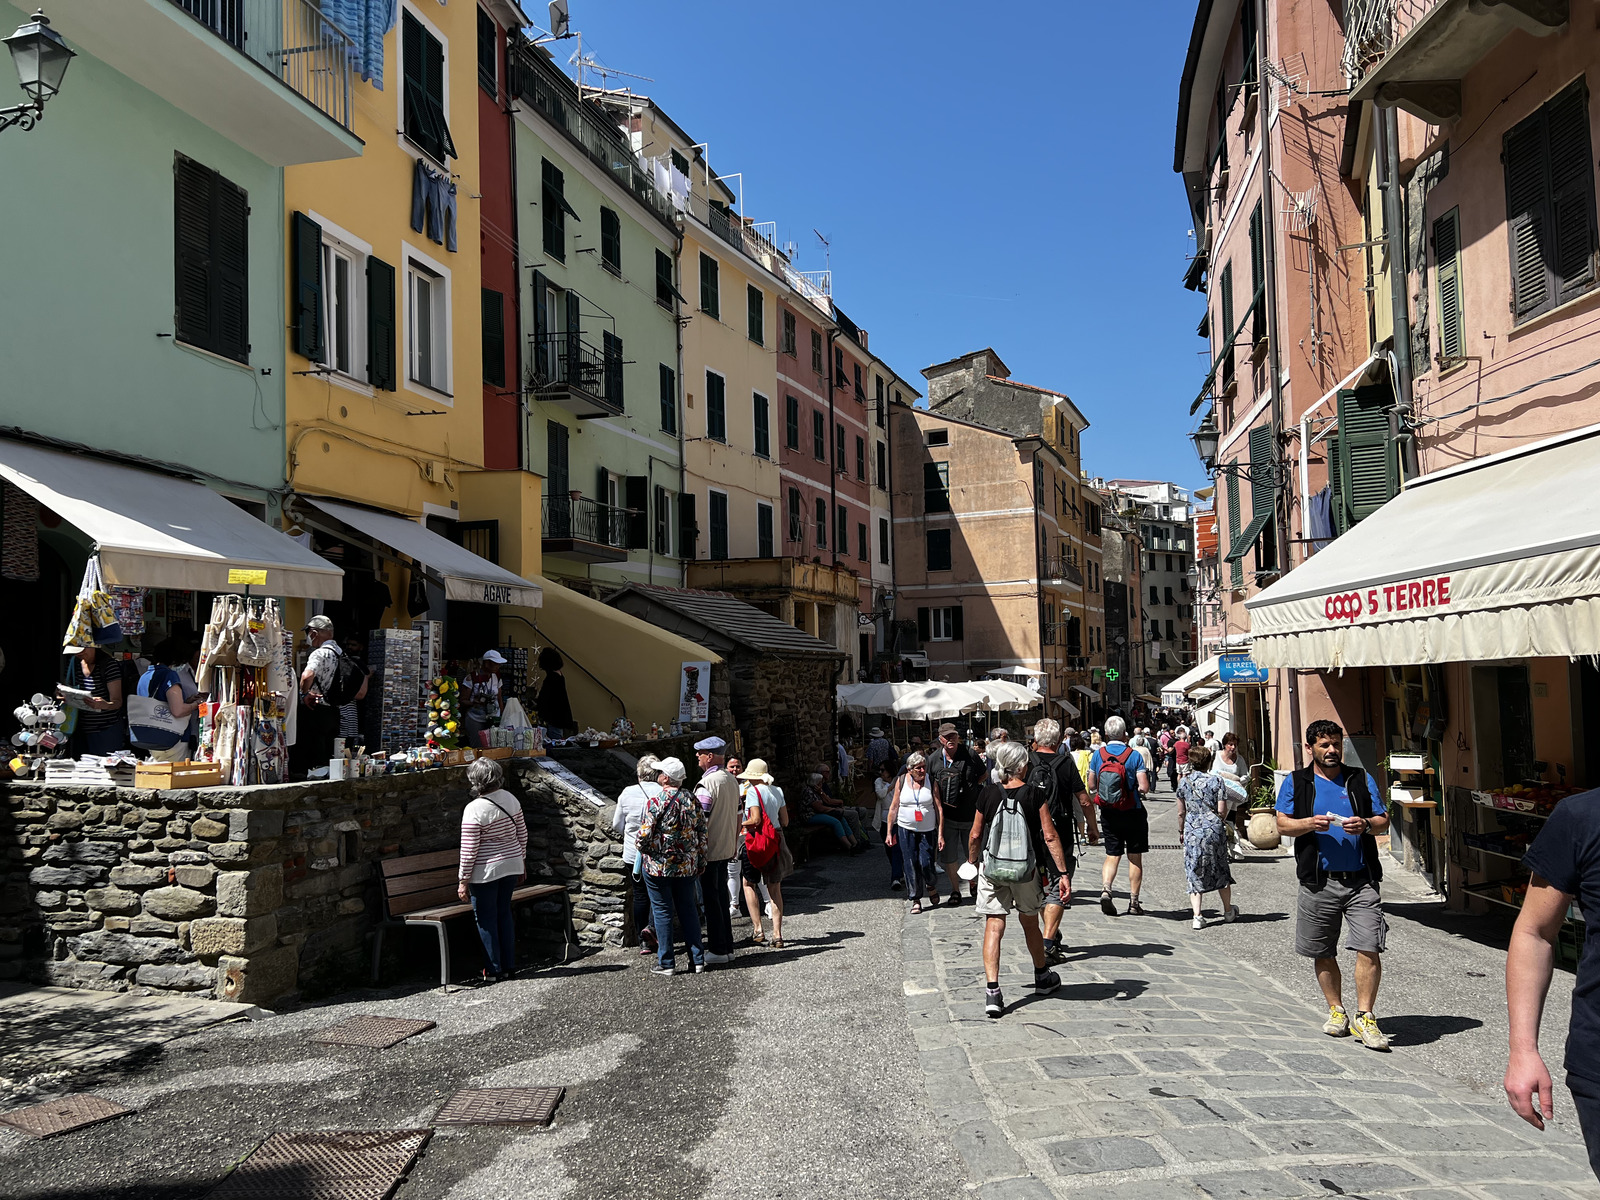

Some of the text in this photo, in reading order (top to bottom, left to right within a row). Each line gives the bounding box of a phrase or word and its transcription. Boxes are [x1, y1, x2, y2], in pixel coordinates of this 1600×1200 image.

[483, 584, 512, 603] AGAVE
[1368, 590, 1378, 615] 5
[1383, 576, 1451, 612] TERRE
